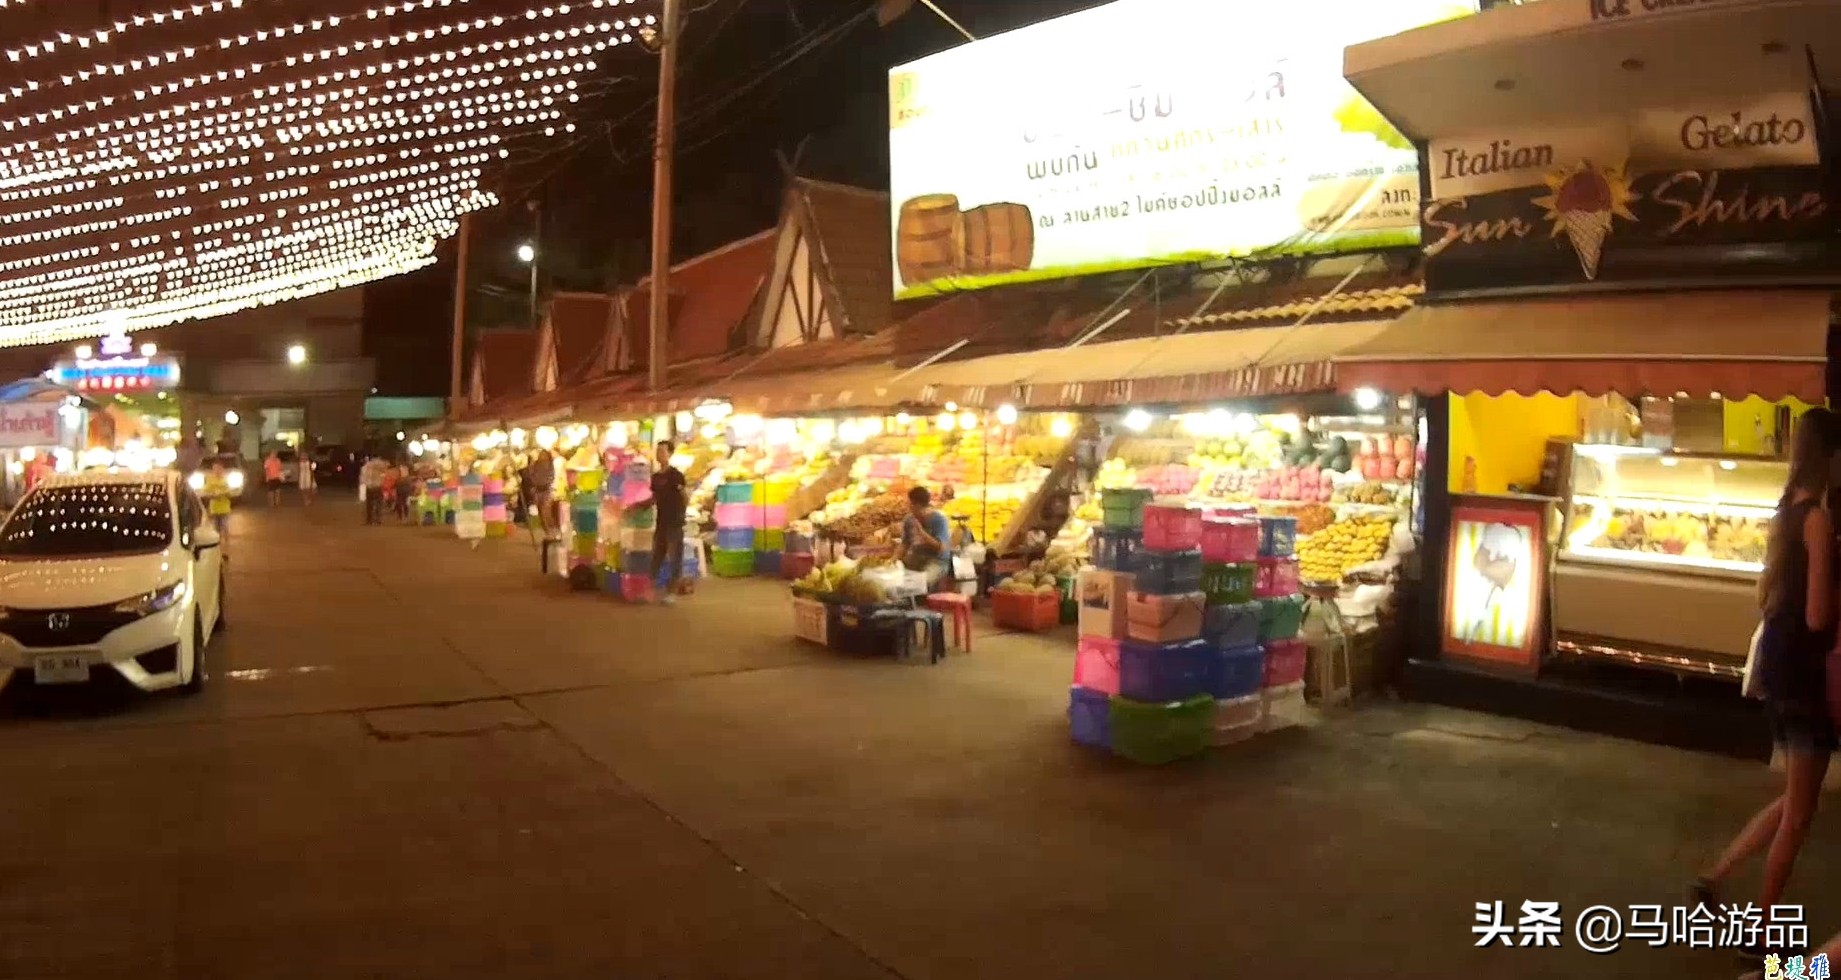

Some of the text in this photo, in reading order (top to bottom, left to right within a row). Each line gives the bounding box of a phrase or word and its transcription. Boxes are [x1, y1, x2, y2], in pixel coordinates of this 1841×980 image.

[1680, 112, 1806, 152] Gelato
[1026, 145, 1099, 181] พบกัน
[1440, 139, 1554, 180] Italian
[1422, 170, 1828, 257] Sun Shine
